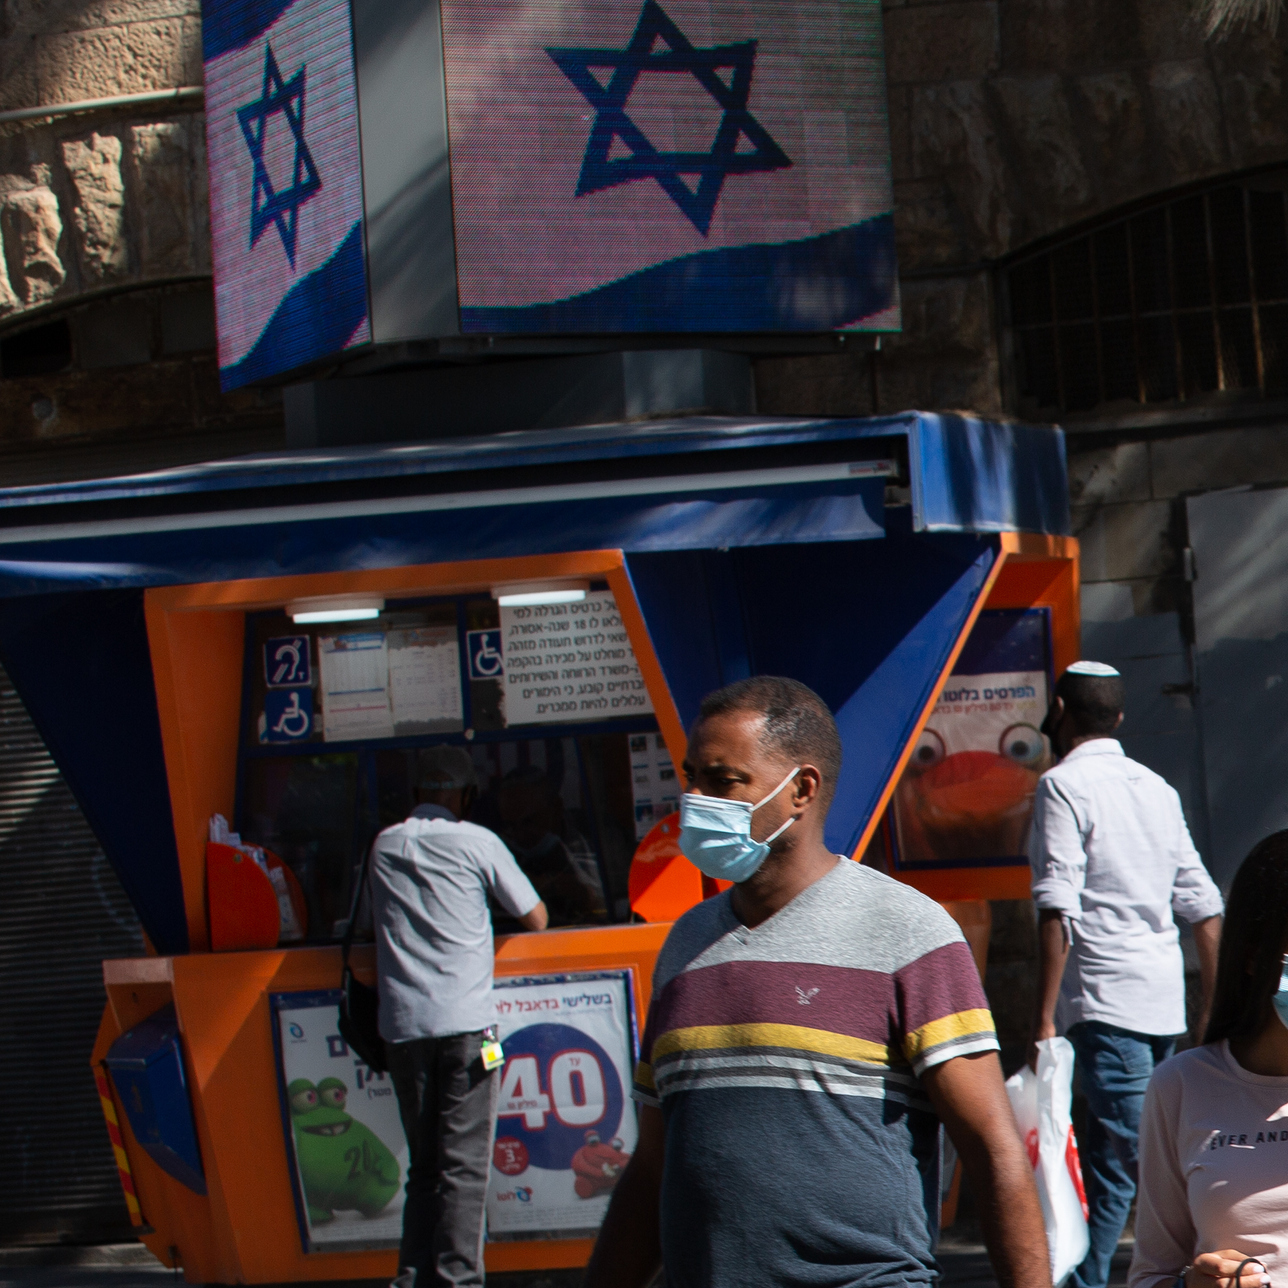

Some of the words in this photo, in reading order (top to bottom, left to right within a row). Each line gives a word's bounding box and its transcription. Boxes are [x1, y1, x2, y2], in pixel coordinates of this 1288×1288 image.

[533, 604, 568, 617] הגרלה
[569, 601, 602, 613] כרטיס
[574, 619, 587, 630] 18
[589, 615, 599, 628] לו
[602, 614, 622, 627] לאו
[538, 636, 572, 649] תעודה
[573, 632, 605, 646] לדרוש
[606, 631, 628, 643] שאי
[545, 652, 576, 664] מכירה
[577, 649, 592, 662] על
[594, 648, 626, 661] מוחלט
[298, 671, 305, 681] T
[522, 685, 561, 699] הימורים
[563, 684, 574, 695] כי
[943, 687, 980, 702] בלוטו
[983, 686, 1035, 700] הפרסים
[580, 695, 608, 710] להיות
[610, 693, 646, 708] עלולים
[514, 998, 559, 1014] בדאבל
[562, 993, 612, 1009] בשלישי
[497, 1048, 609, 1132] 40
[1255, 1129, 1288, 1144] AND
